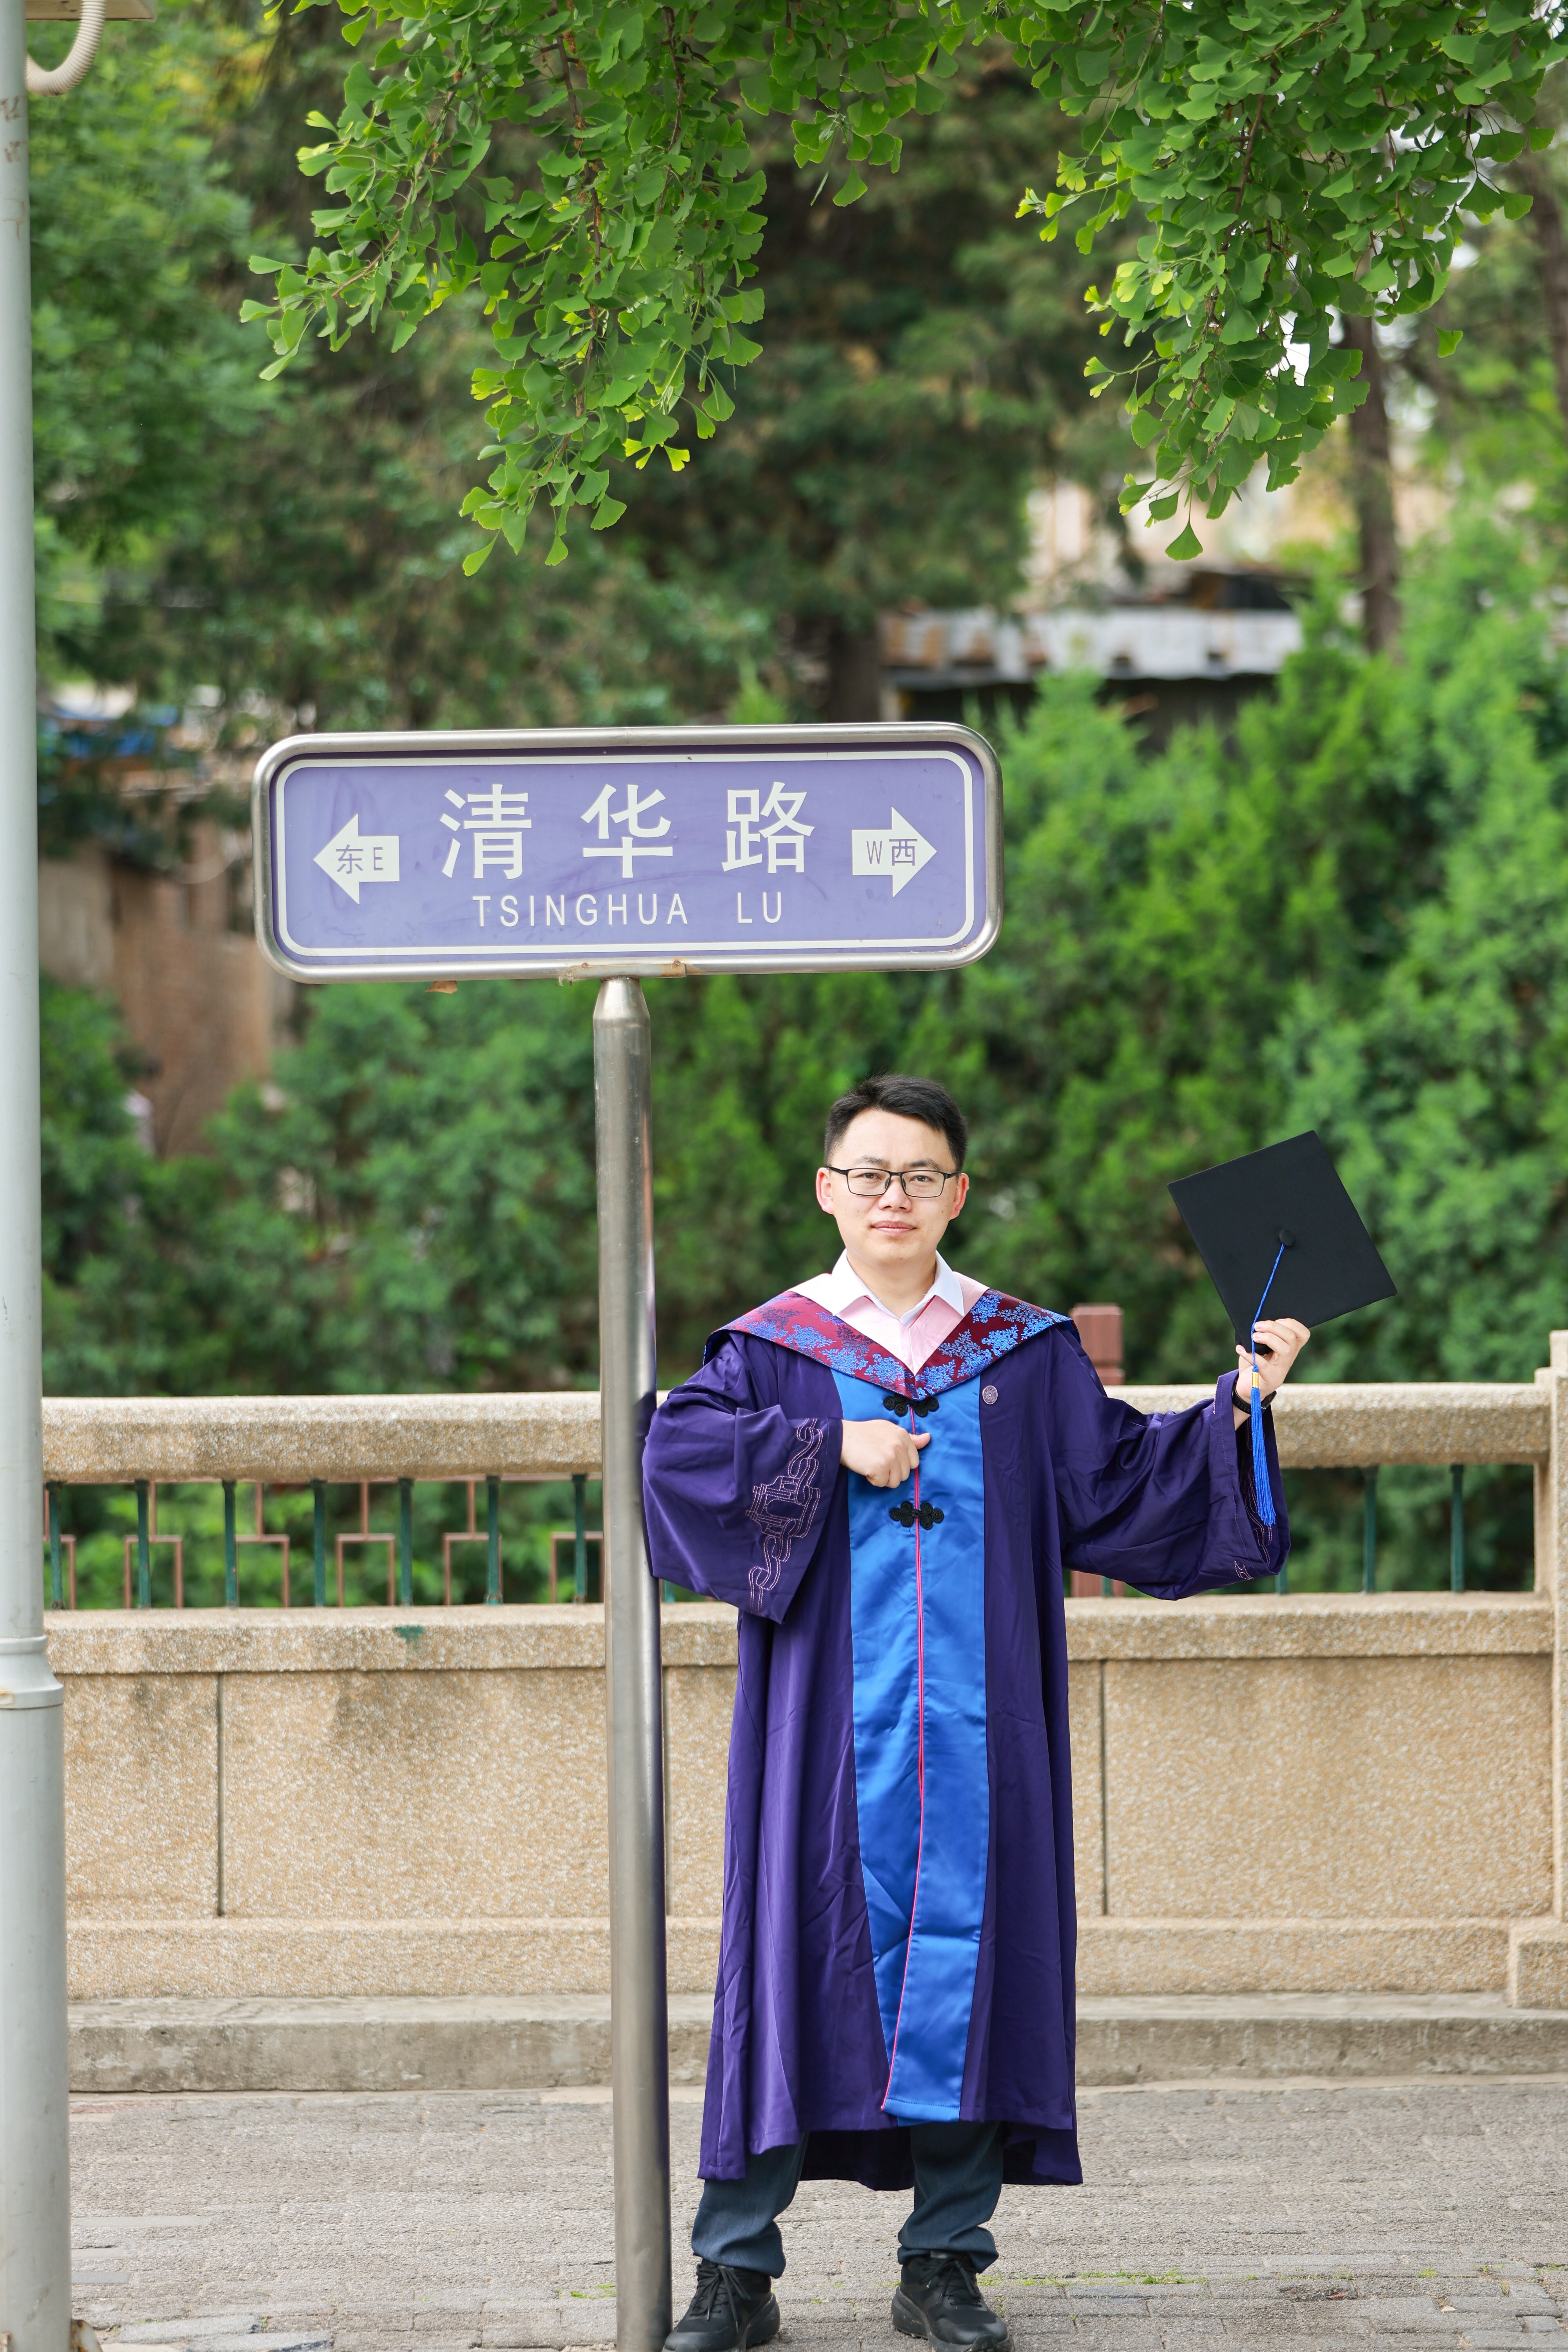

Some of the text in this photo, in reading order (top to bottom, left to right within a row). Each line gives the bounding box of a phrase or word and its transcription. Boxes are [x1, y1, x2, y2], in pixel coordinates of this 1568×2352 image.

[440, 782, 815, 880] 清华路
[336, 844, 384, 875] 东 E
[866, 838, 918, 866] W 西
[472, 891, 781, 927] TSINGHUA LU
